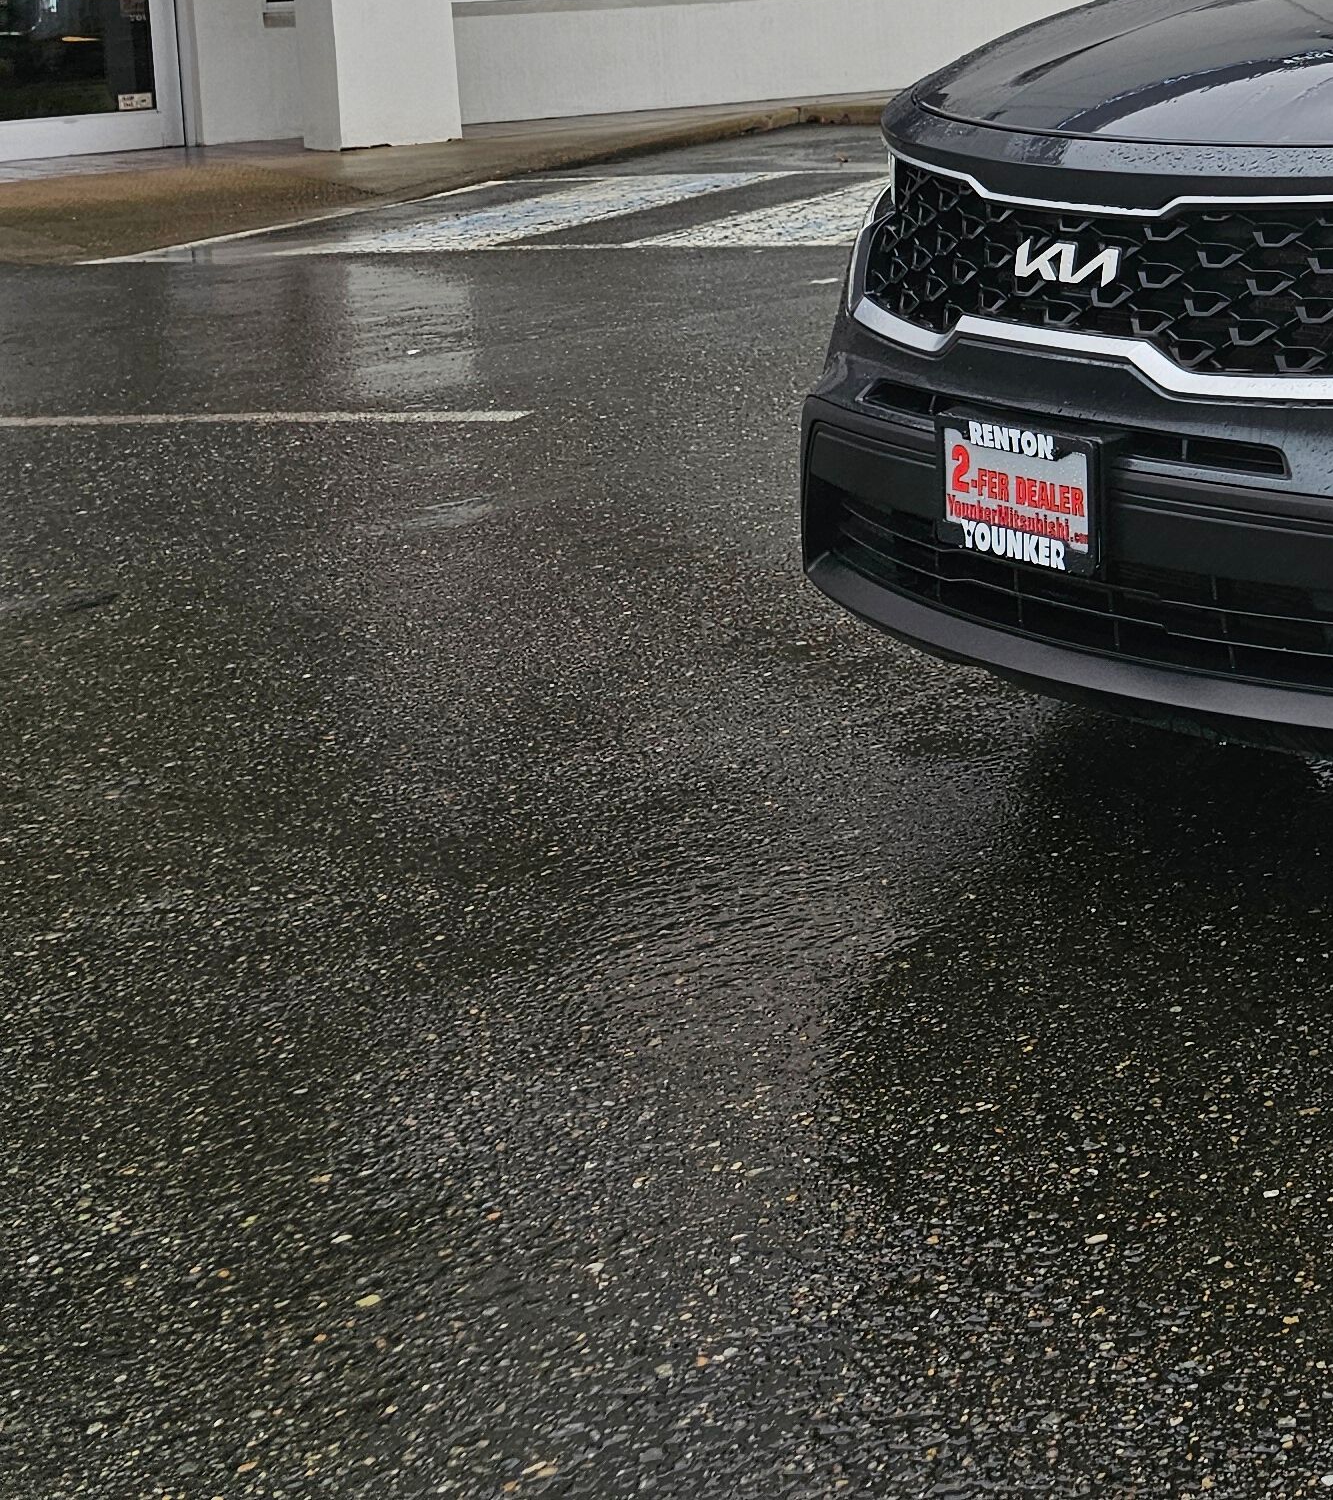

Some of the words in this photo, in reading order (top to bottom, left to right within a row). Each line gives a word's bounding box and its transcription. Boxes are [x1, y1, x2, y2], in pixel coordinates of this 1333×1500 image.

[1014, 238, 1119, 288] KIA
[968, 420, 1054, 461] RENTON
[951, 444, 1010, 503] 2-FER
[1015, 475, 1085, 518] DEALER
[947, 493, 1089, 545] YounkerMitsubishi.com
[961, 519, 1066, 571] YOUNKER
